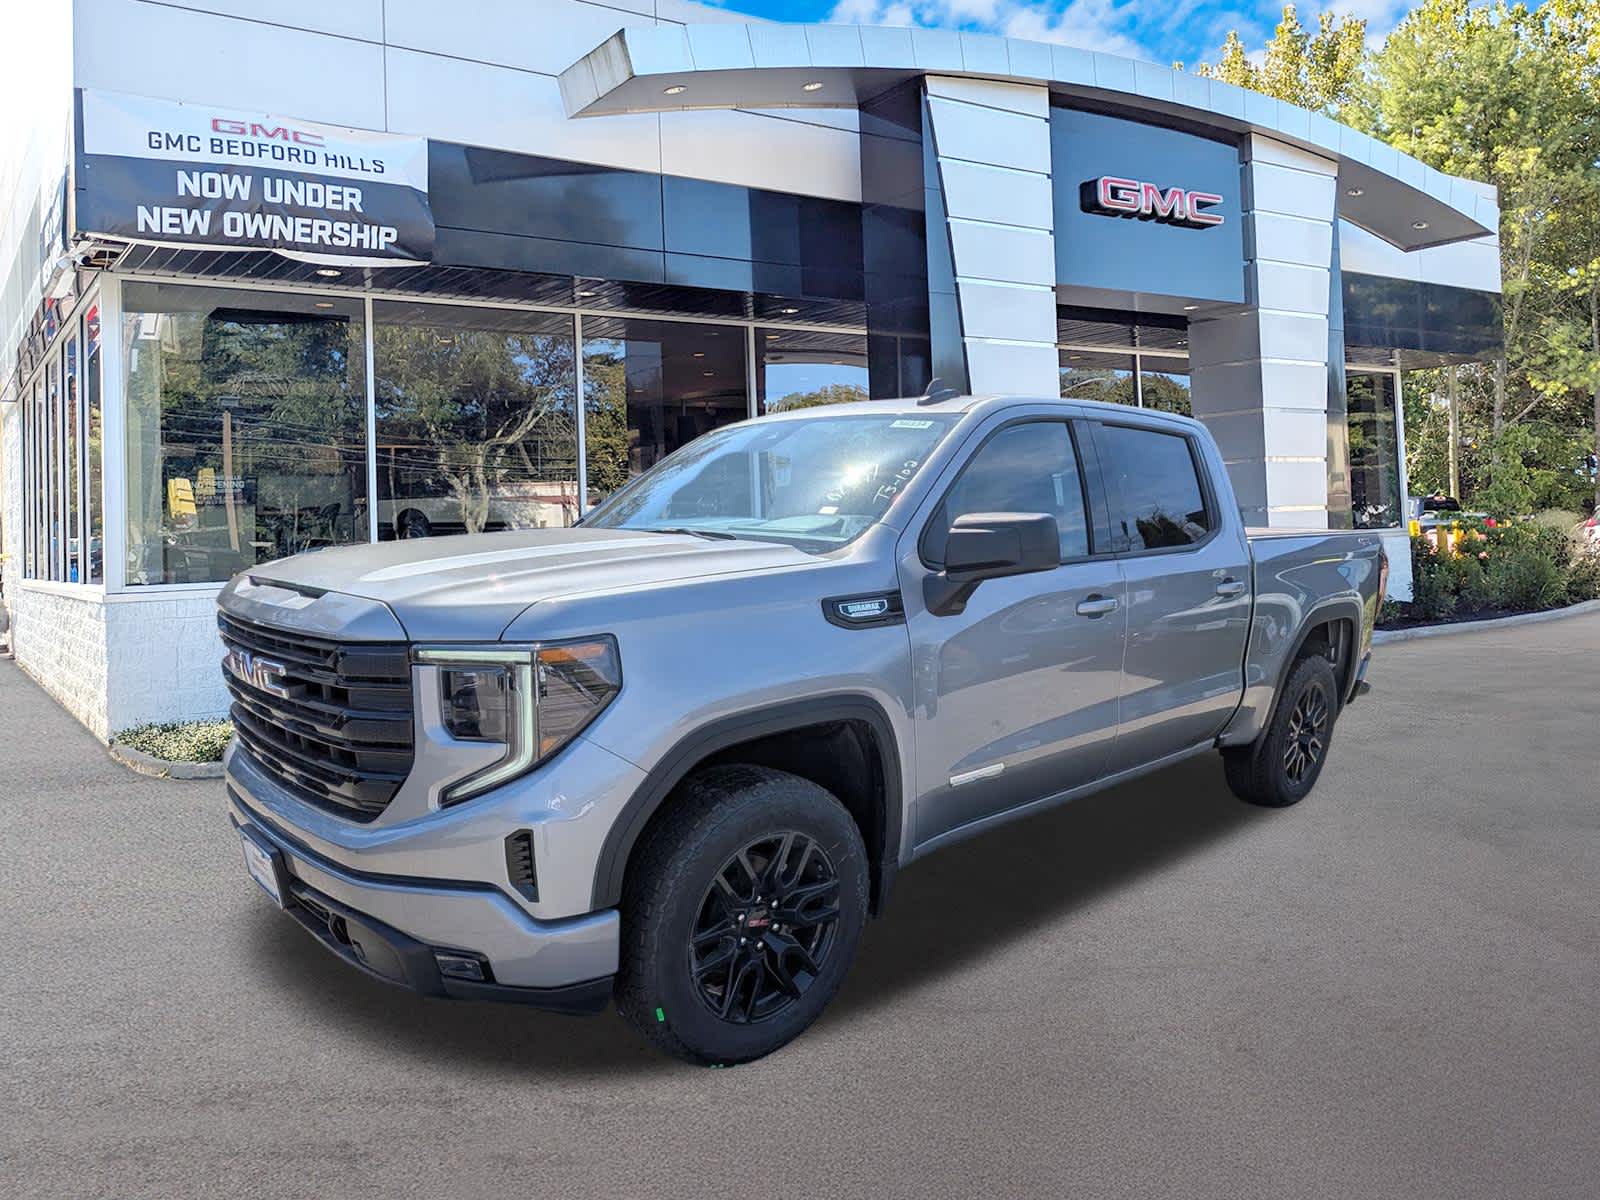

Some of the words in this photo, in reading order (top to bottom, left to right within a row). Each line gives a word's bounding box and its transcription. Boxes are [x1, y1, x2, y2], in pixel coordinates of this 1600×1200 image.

[148, 131, 200, 152] GMC
[210, 139, 317, 165] BEDFORD
[325, 153, 385, 174] HILLS
[211, 118, 326, 147] GMC
[177, 171, 252, 201] NOW
[263, 176, 364, 213] UNDER
[1097, 176, 1224, 224] GMC
[137, 206, 211, 236] NEW
[223, 211, 398, 250] OWNERSHIP
